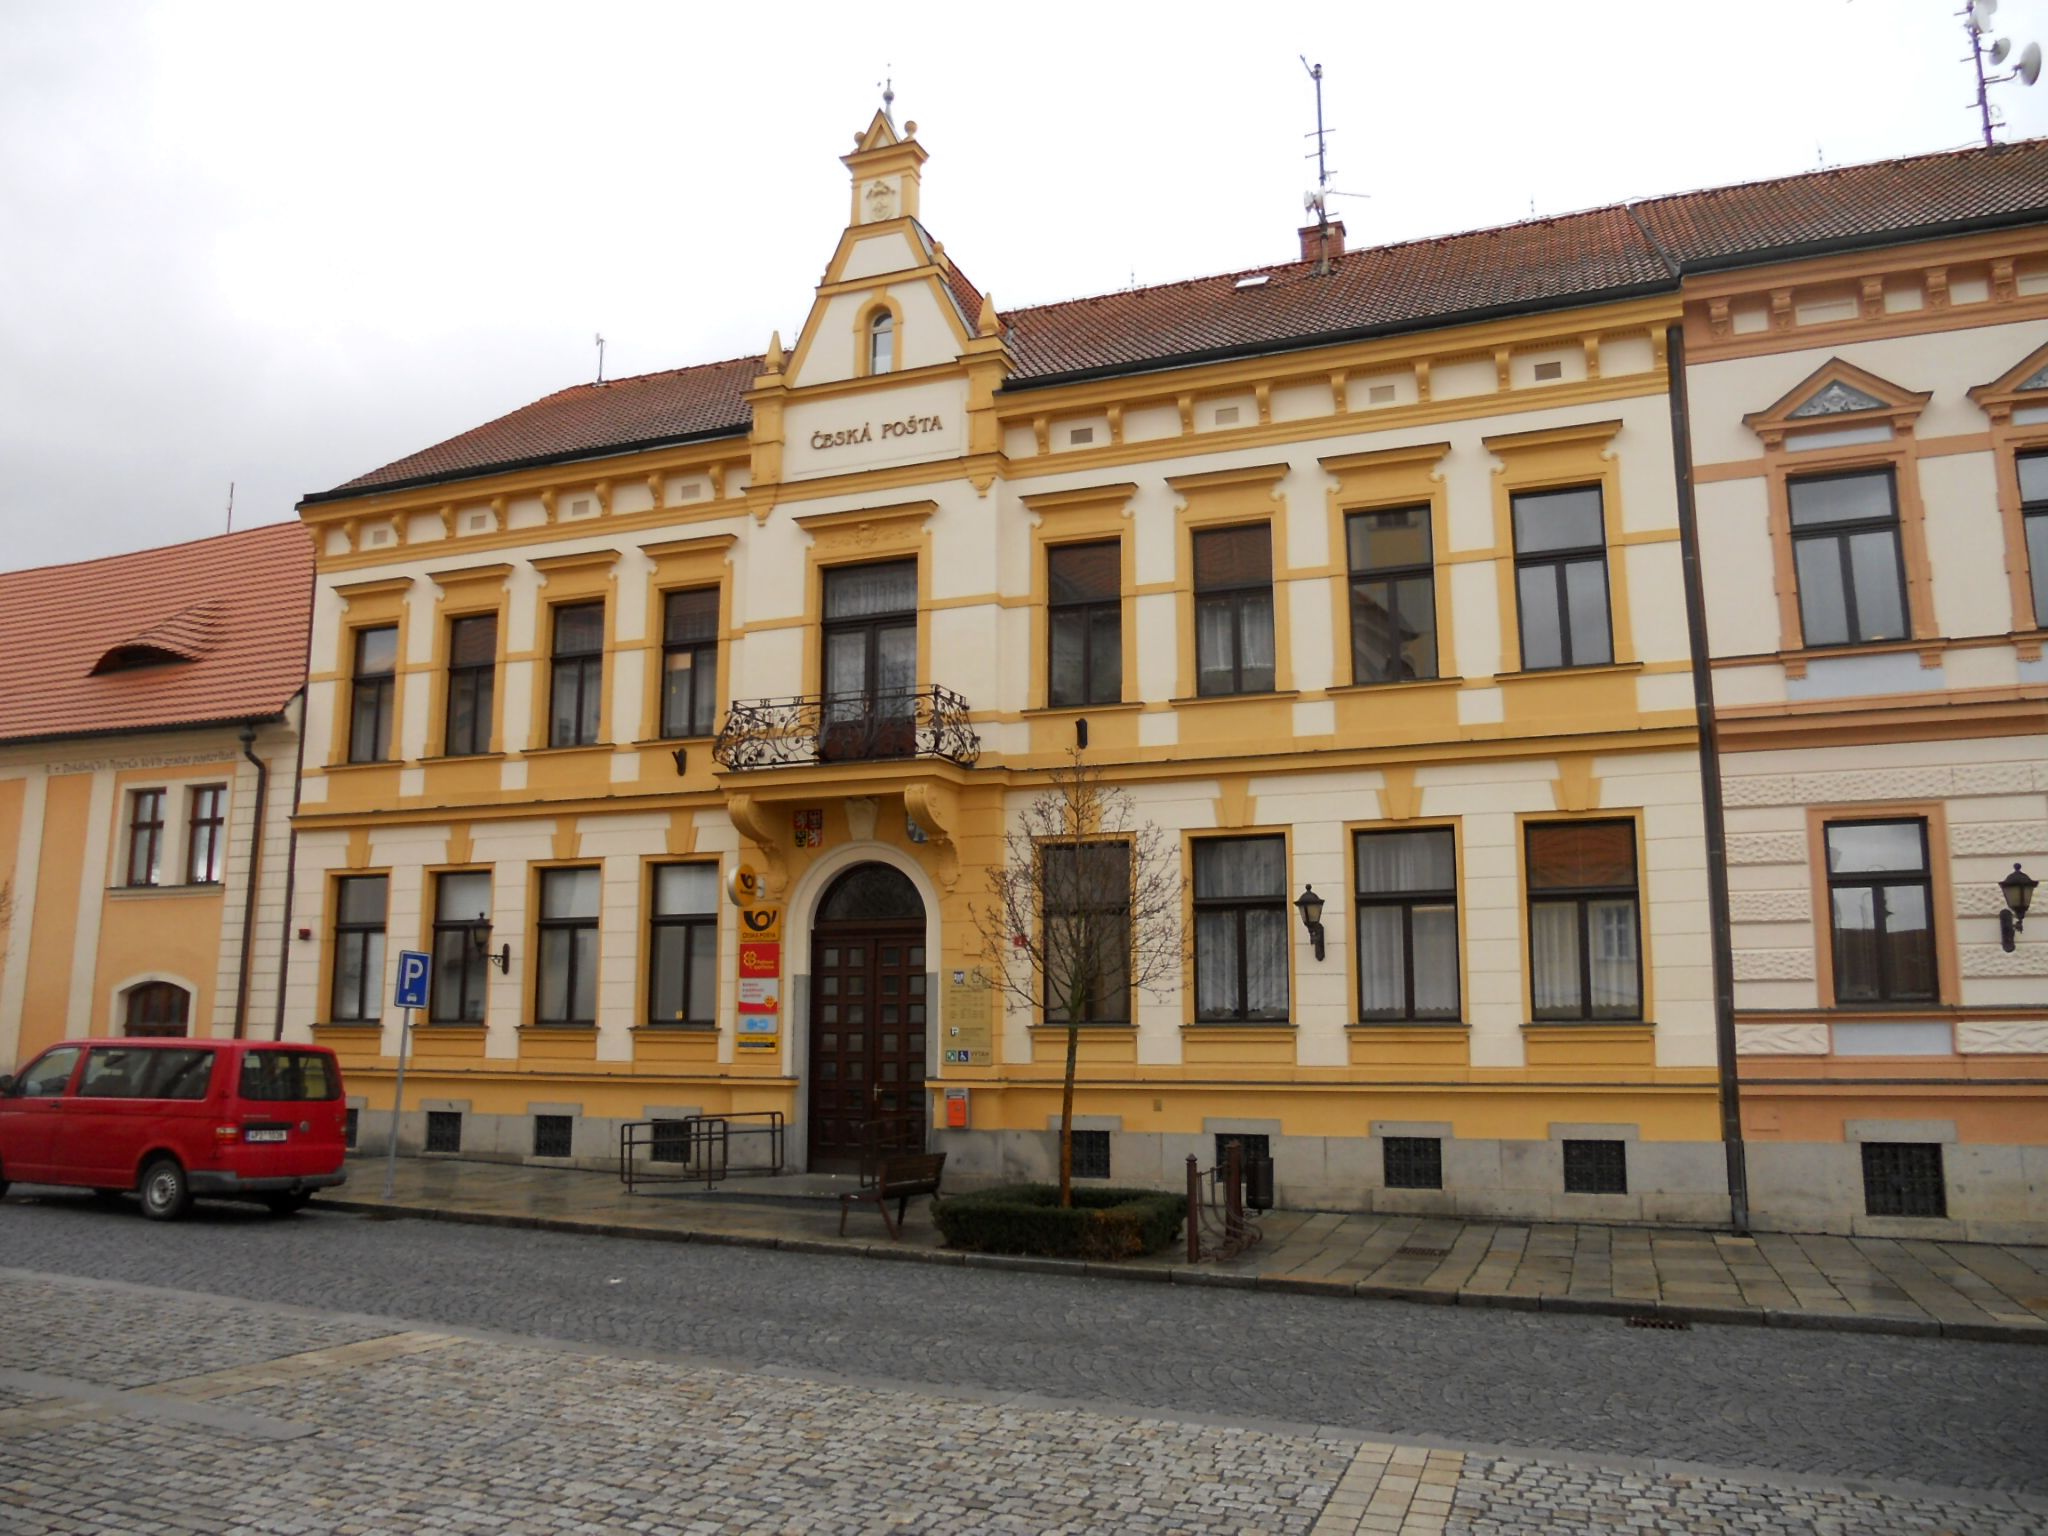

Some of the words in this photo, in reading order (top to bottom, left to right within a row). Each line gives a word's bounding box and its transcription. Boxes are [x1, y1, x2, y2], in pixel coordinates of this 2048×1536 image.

[810, 422, 872, 450] ČESKÁ
[881, 415, 943, 440] POŠTA
[403, 958, 424, 990] P
